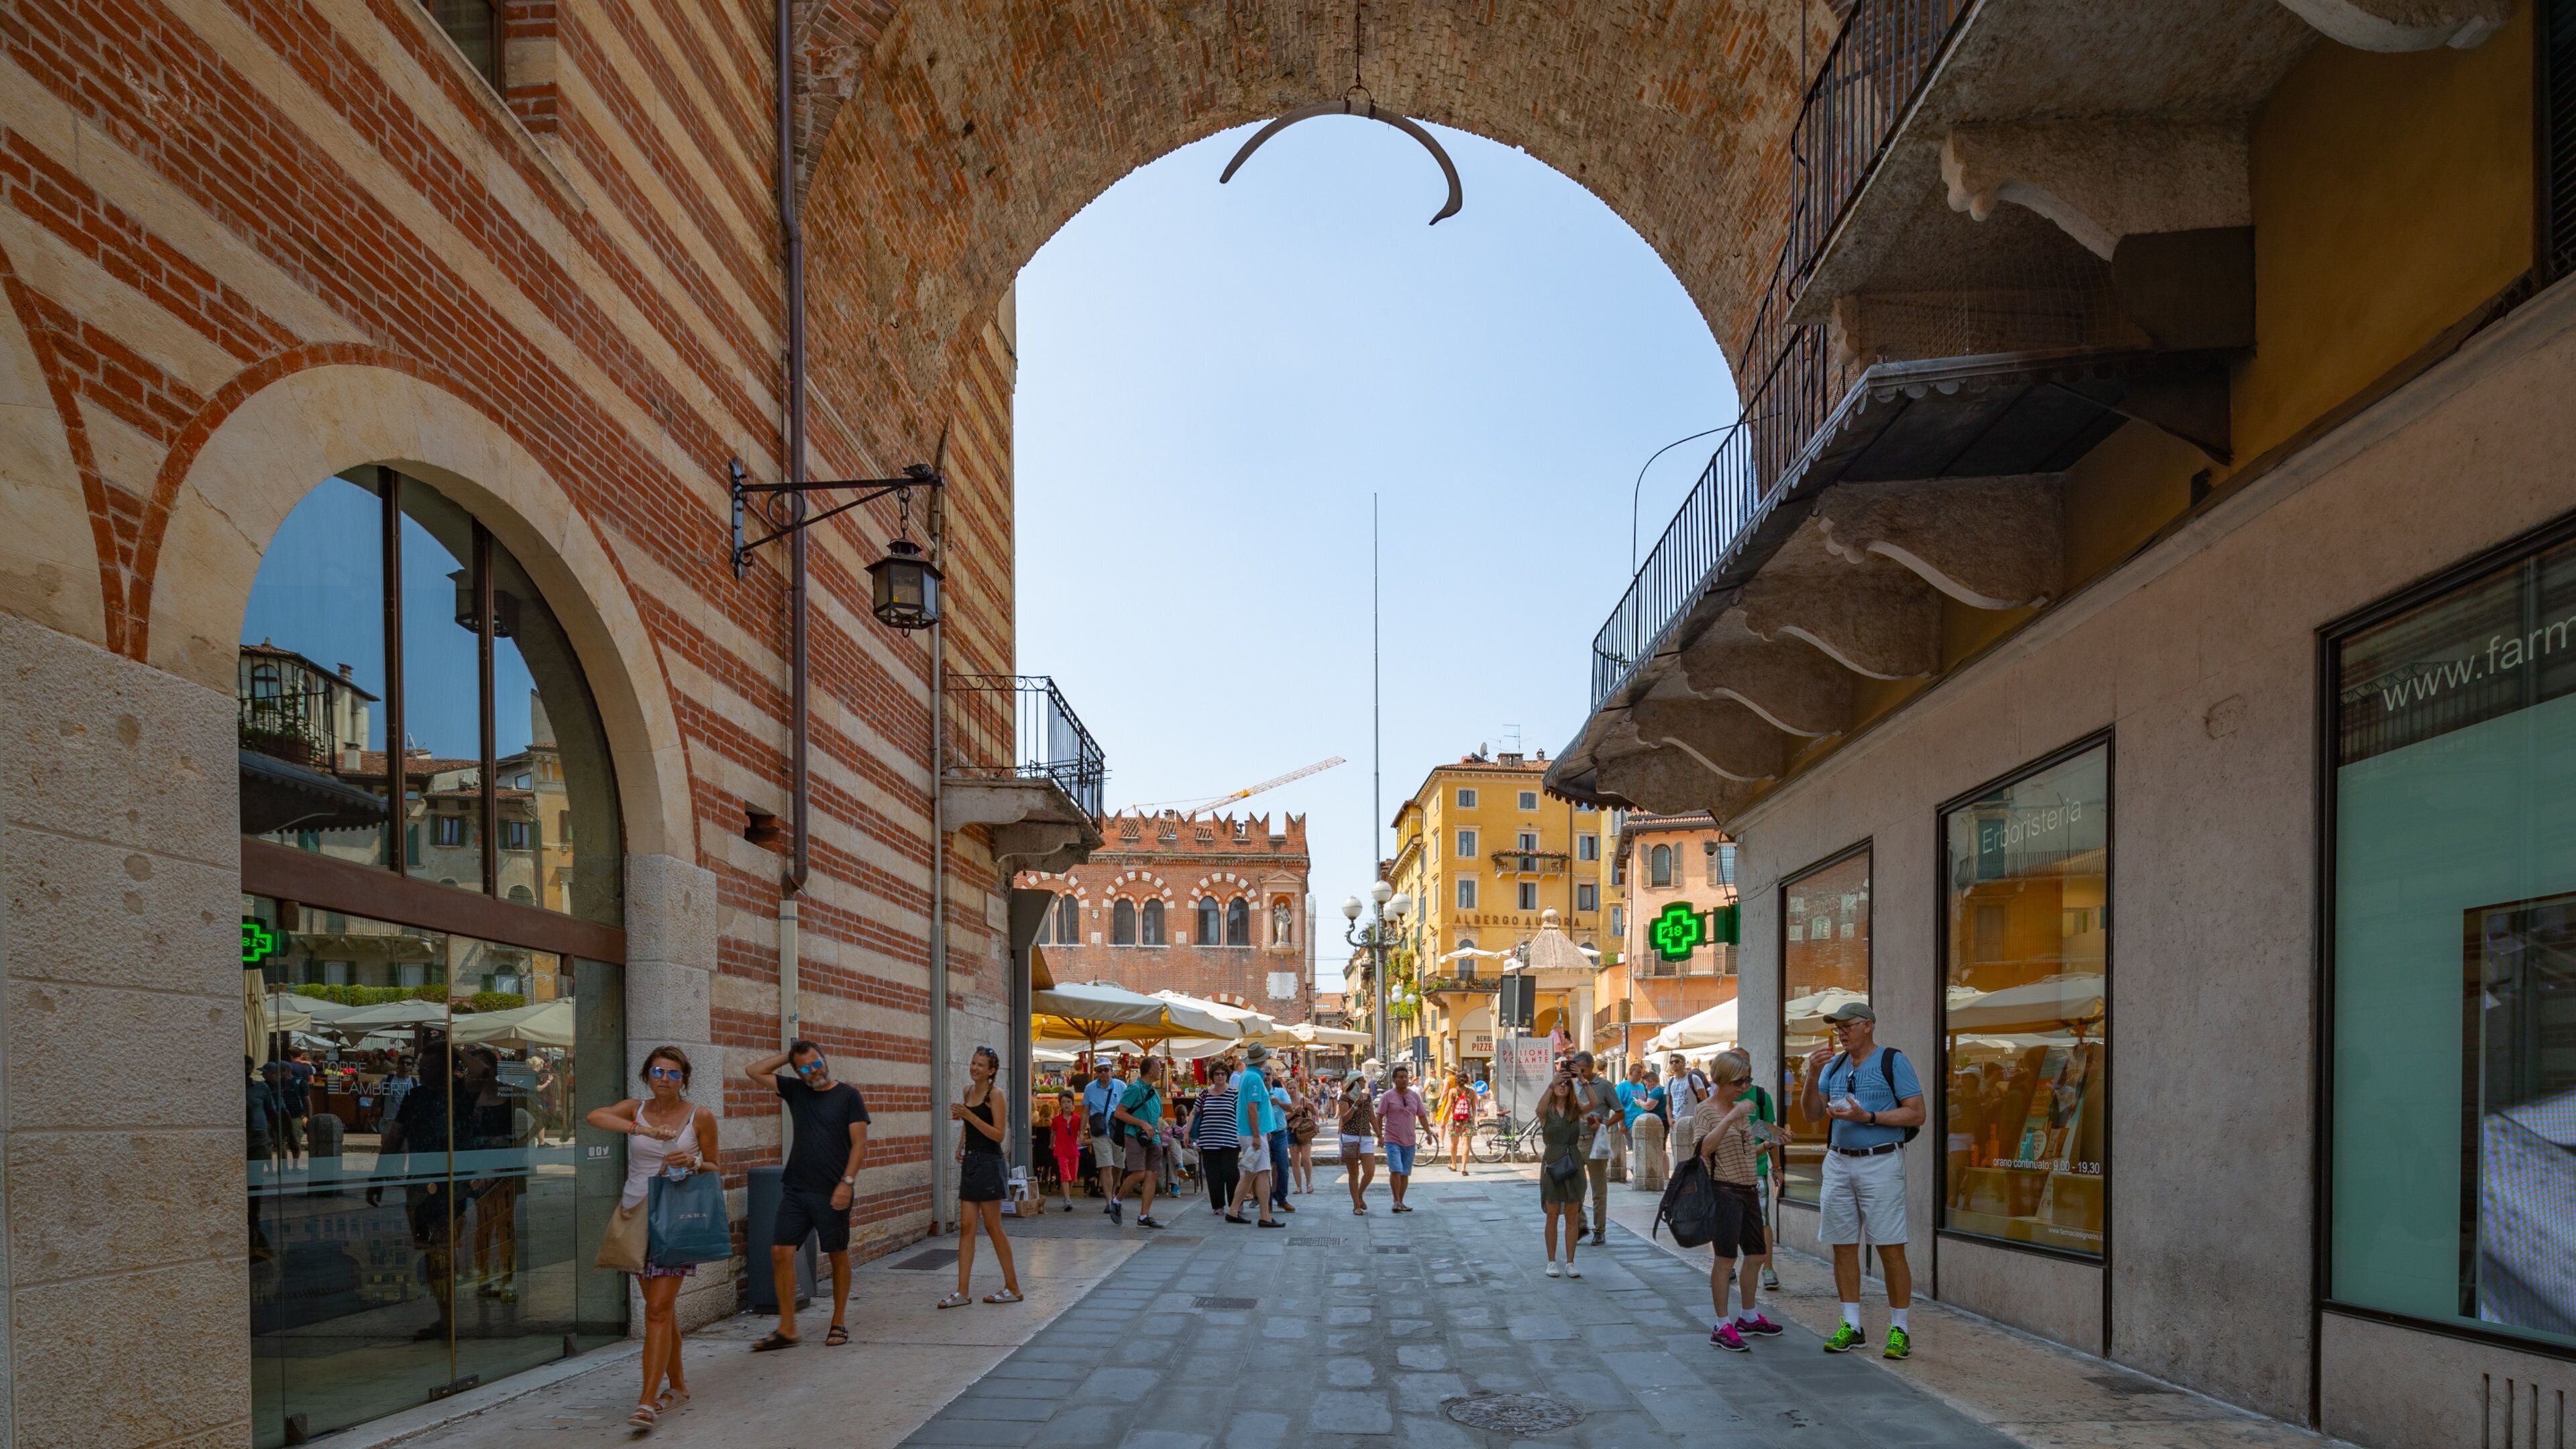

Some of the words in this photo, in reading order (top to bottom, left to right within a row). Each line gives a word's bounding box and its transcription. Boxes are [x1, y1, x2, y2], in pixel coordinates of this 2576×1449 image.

[1982, 798, 2082, 855] Erboristeria
[1455, 914, 1519, 926] ALBERGO
[1525, 916, 1580, 927] AUORA
[1472, 1042, 1494, 1052] PIZZE
[1503, 1049, 1549, 1057] PASIONE
[319, 1061, 366, 1073] TORRE
[2013, 1159, 2051, 1171] continuato:
[2078, 1161, 2100, 1175] 19,30
